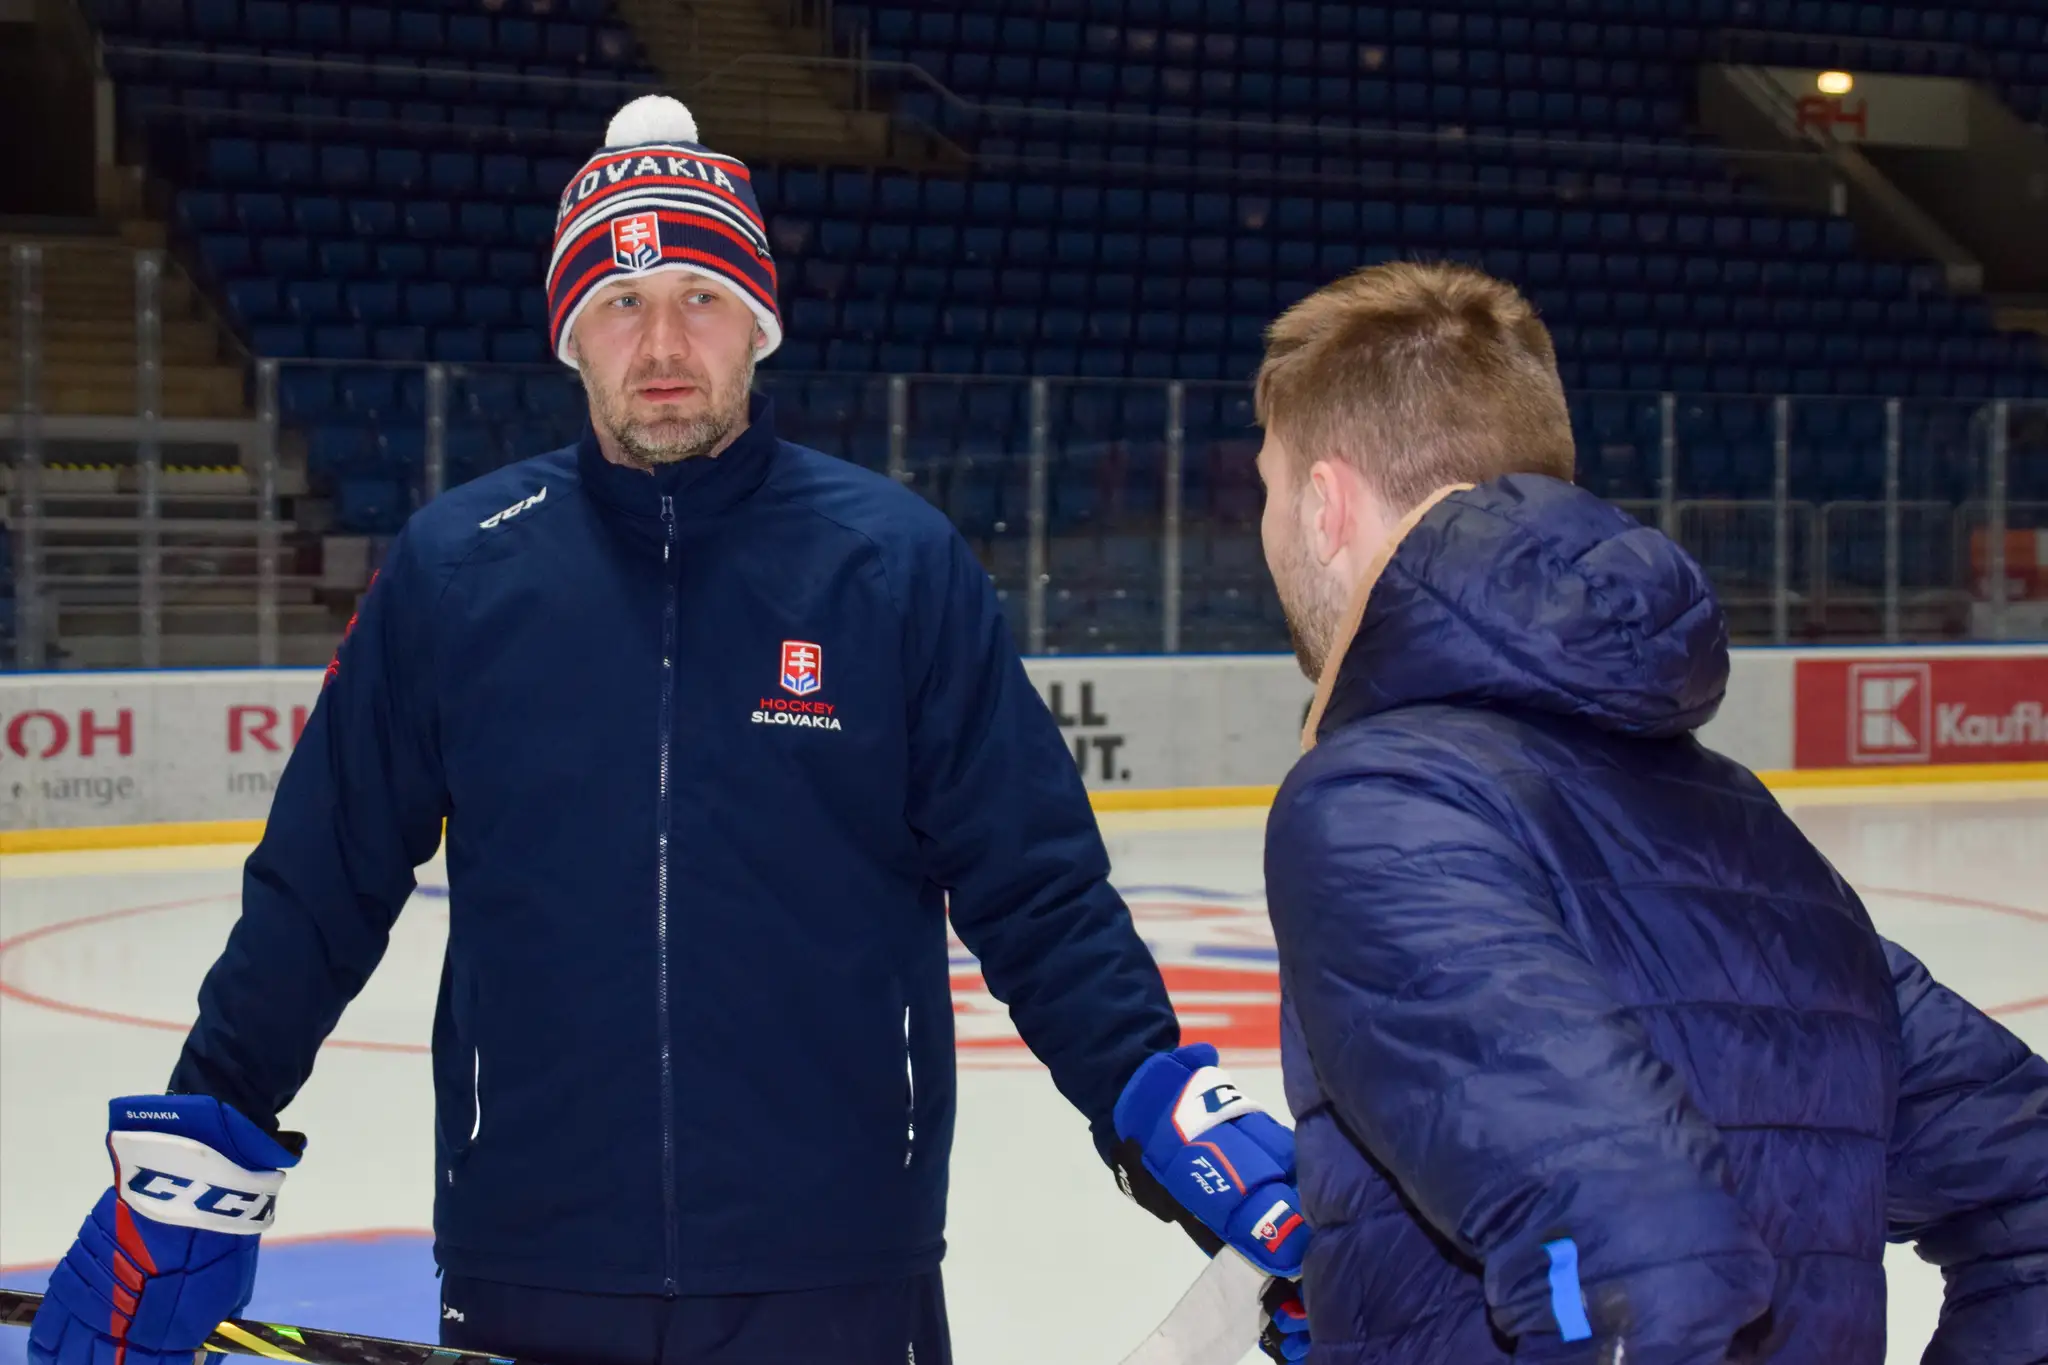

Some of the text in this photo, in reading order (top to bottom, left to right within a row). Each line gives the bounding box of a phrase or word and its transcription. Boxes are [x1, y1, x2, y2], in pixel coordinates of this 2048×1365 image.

[759, 697, 836, 716] HOCKEY
[751, 710, 842, 732] SLOVAKIA
[1936, 700, 2048, 749] Kaufl
[0, 706, 135, 760] OH
[126, 1110, 180, 1121] SLOVAKIA
[1190, 1171, 1216, 1195] PRO
